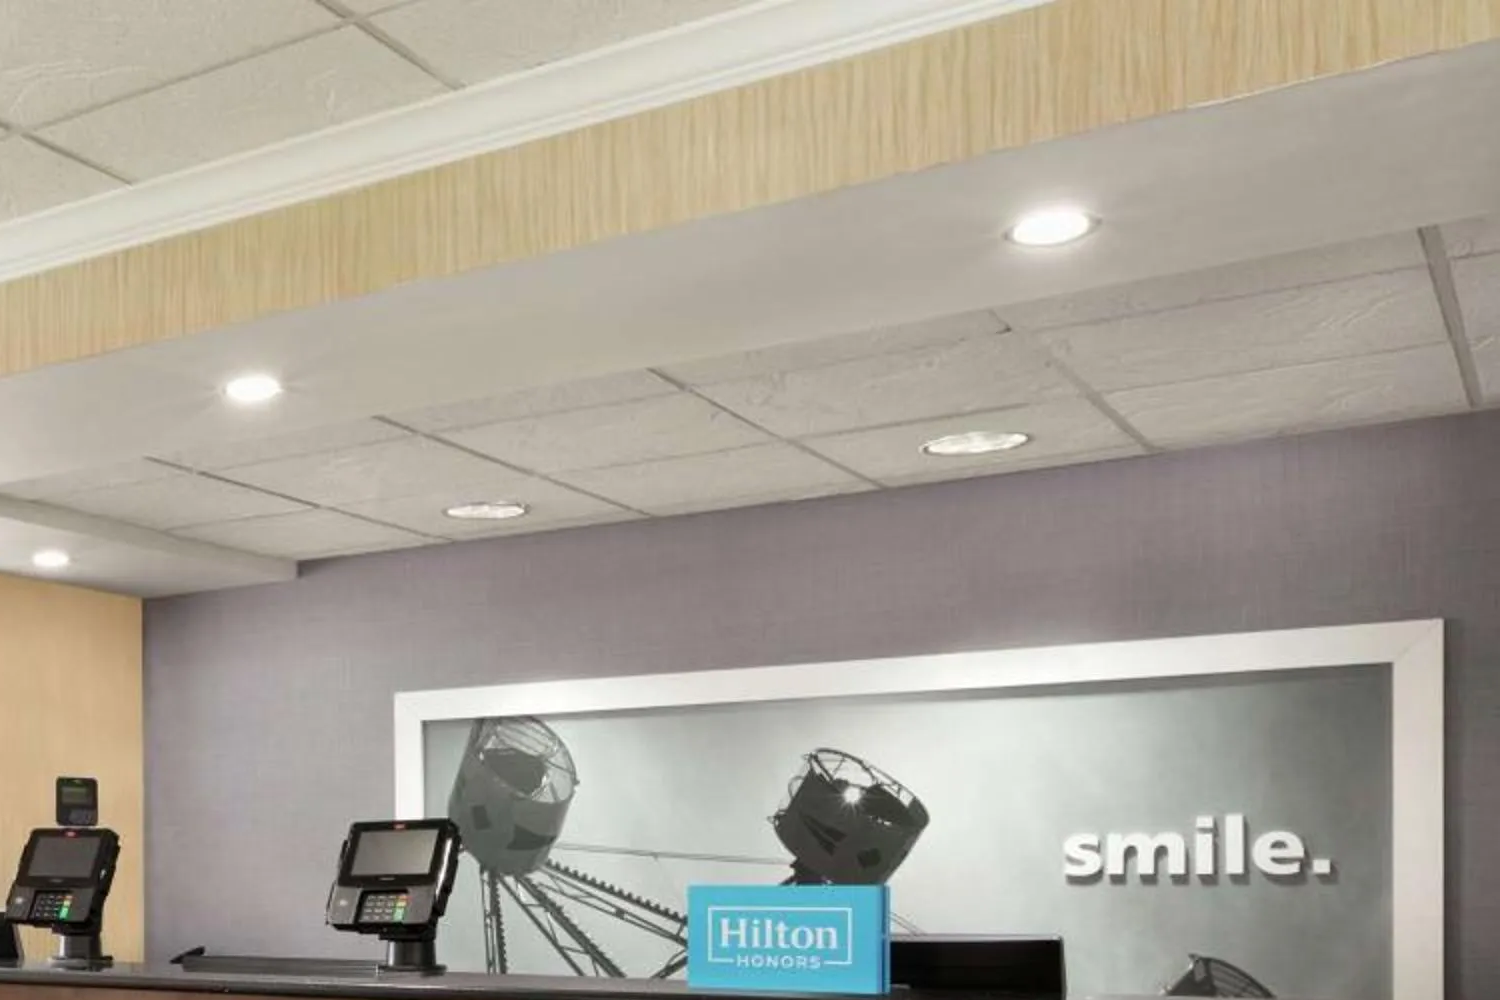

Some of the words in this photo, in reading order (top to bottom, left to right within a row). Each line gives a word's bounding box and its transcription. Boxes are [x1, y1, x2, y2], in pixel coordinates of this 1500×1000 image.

[1063, 813, 1331, 876] smile.
[720, 917, 838, 949] Hilton
[736, 954, 821, 969] HONORS
